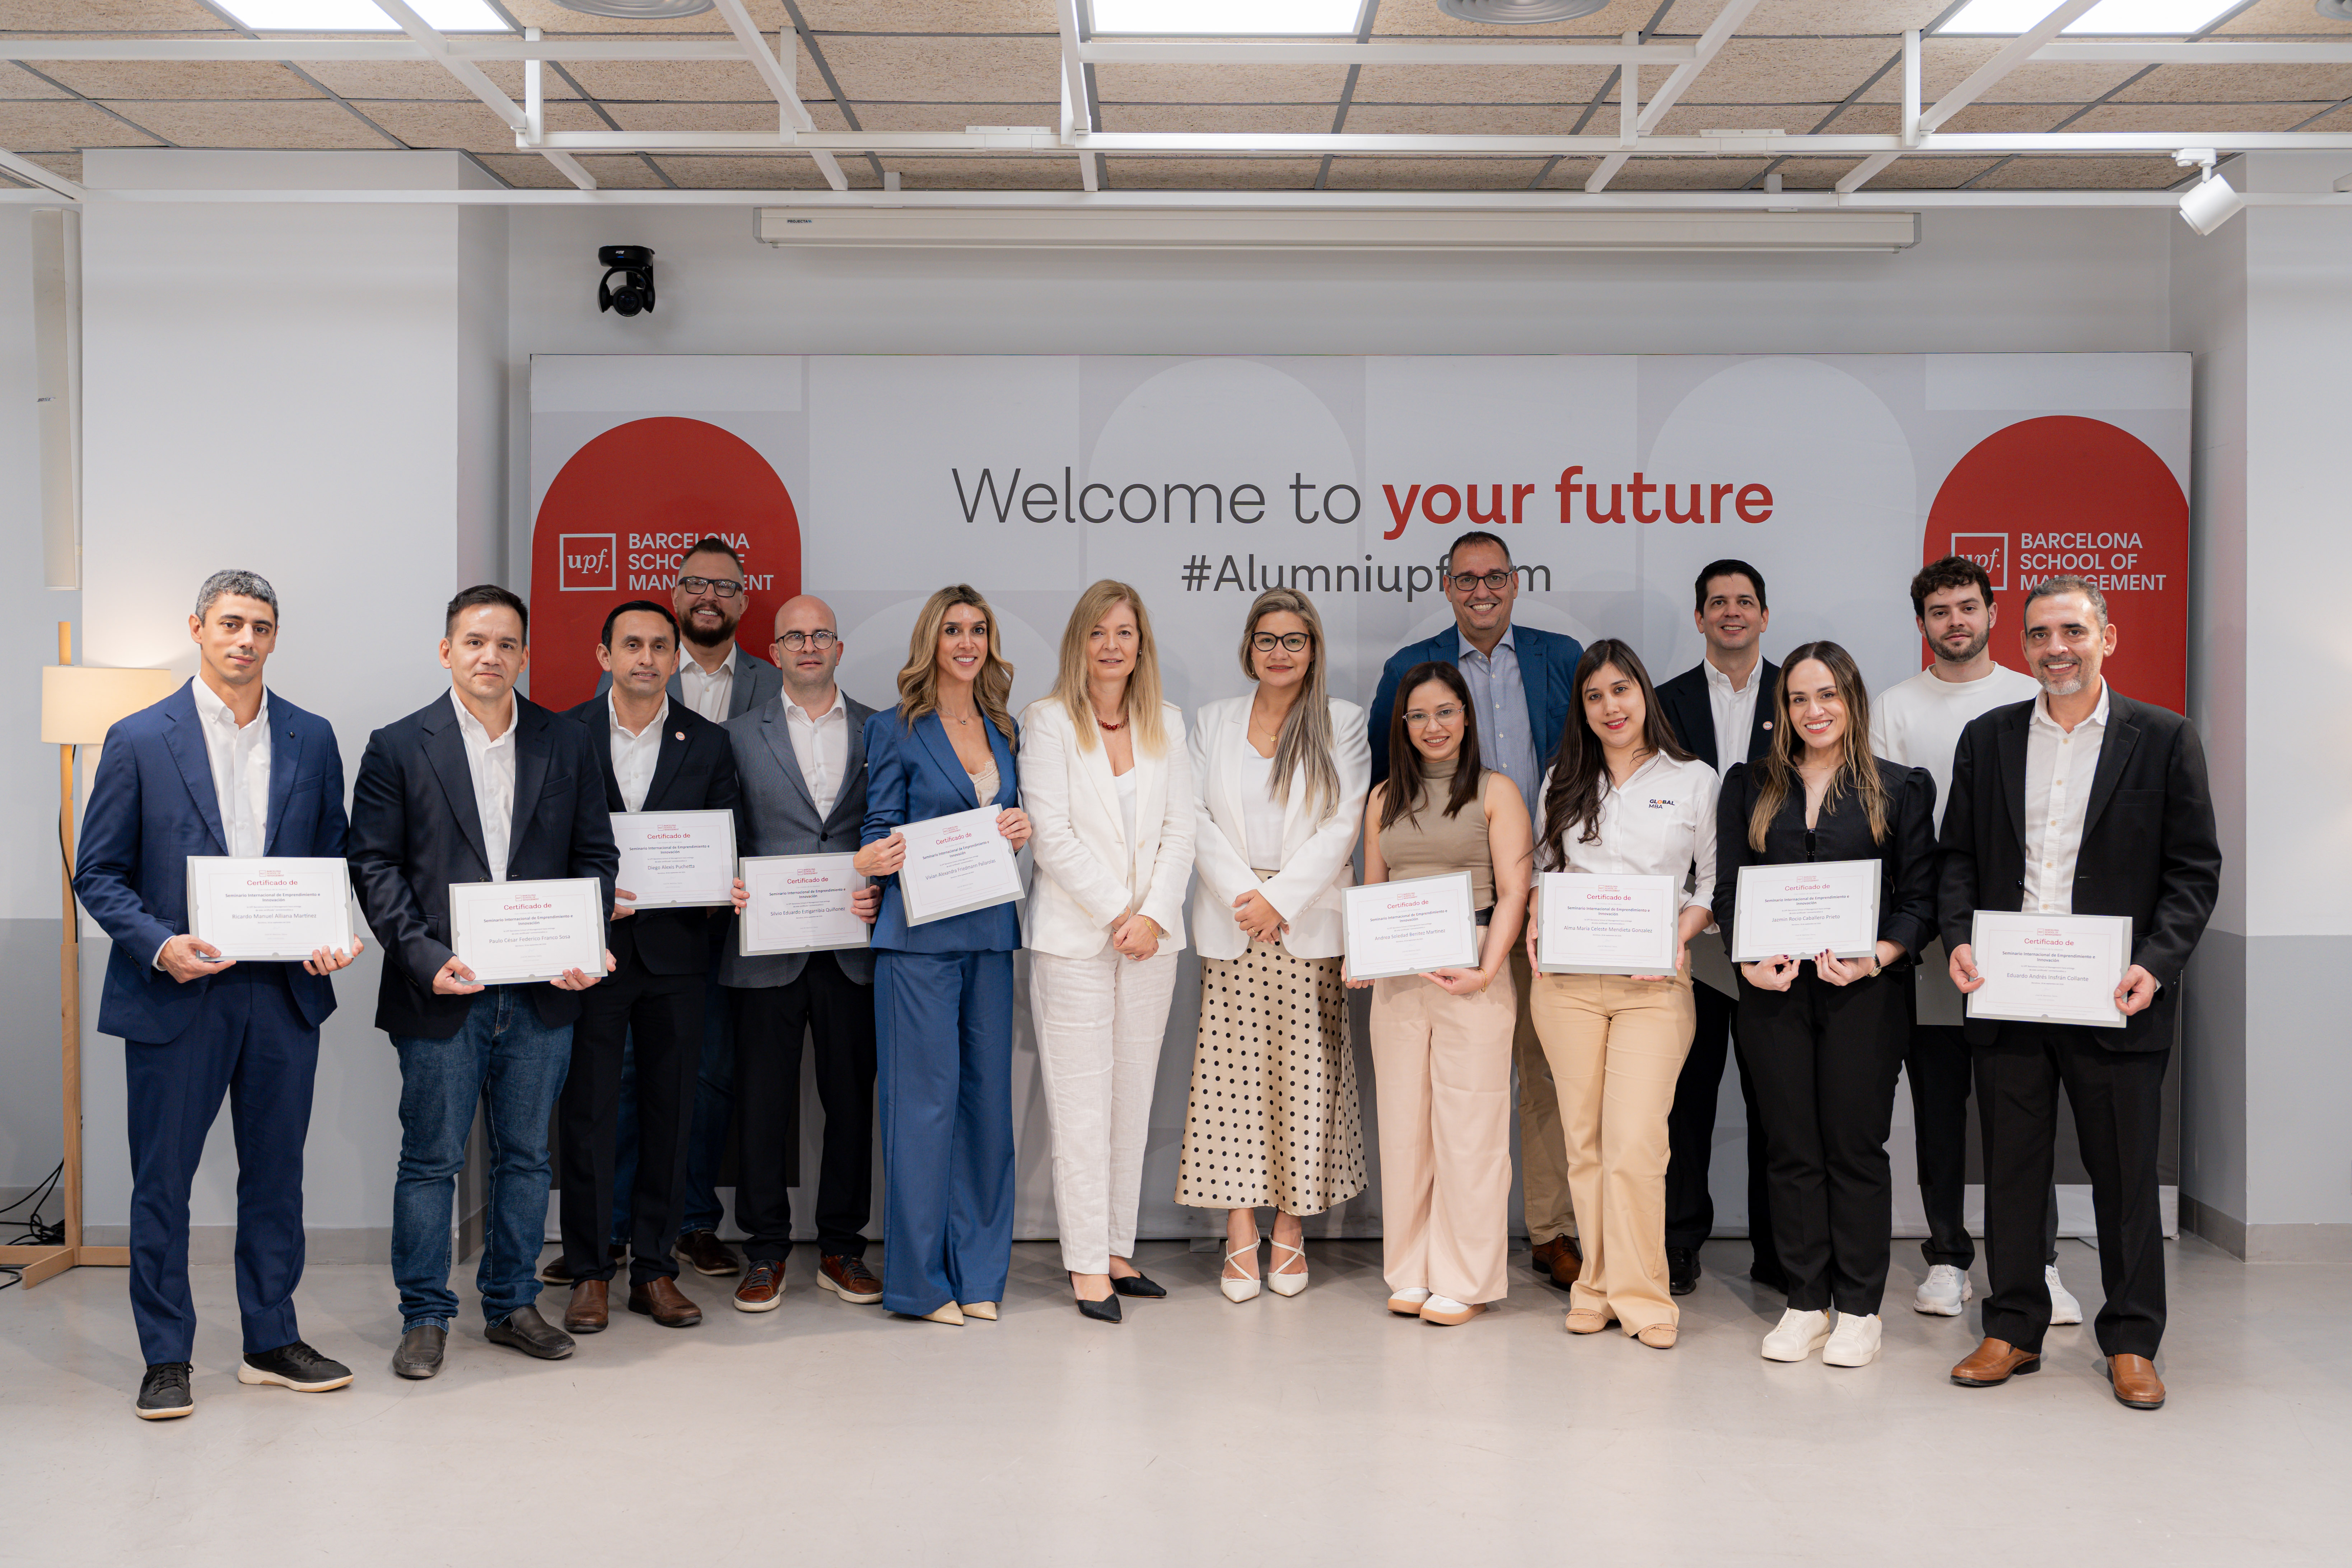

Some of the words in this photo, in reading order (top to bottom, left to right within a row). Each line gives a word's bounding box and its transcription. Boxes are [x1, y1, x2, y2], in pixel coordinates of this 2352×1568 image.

[952, 466, 1265, 524] Welcome
[1289, 473, 1361, 524] to
[1382, 484, 1535, 540] your
[1555, 465, 1773, 524] future
[629, 533, 750, 549] BARCENA
[2021, 532, 2143, 549] BARCELONA
[567, 549, 609, 574] upf.
[629, 554, 683, 570] SCHO
[2020, 553, 2105, 570] SCHOOL
[2111, 553, 2137, 570] OF
[629, 574, 774, 590] MANNT
[1181, 554, 1550, 602] #Alumniupfm
[2020, 574, 2166, 590] MGEMENT
[936, 834, 964, 845] Certificado
[1387, 901, 1420, 909] Certificado
